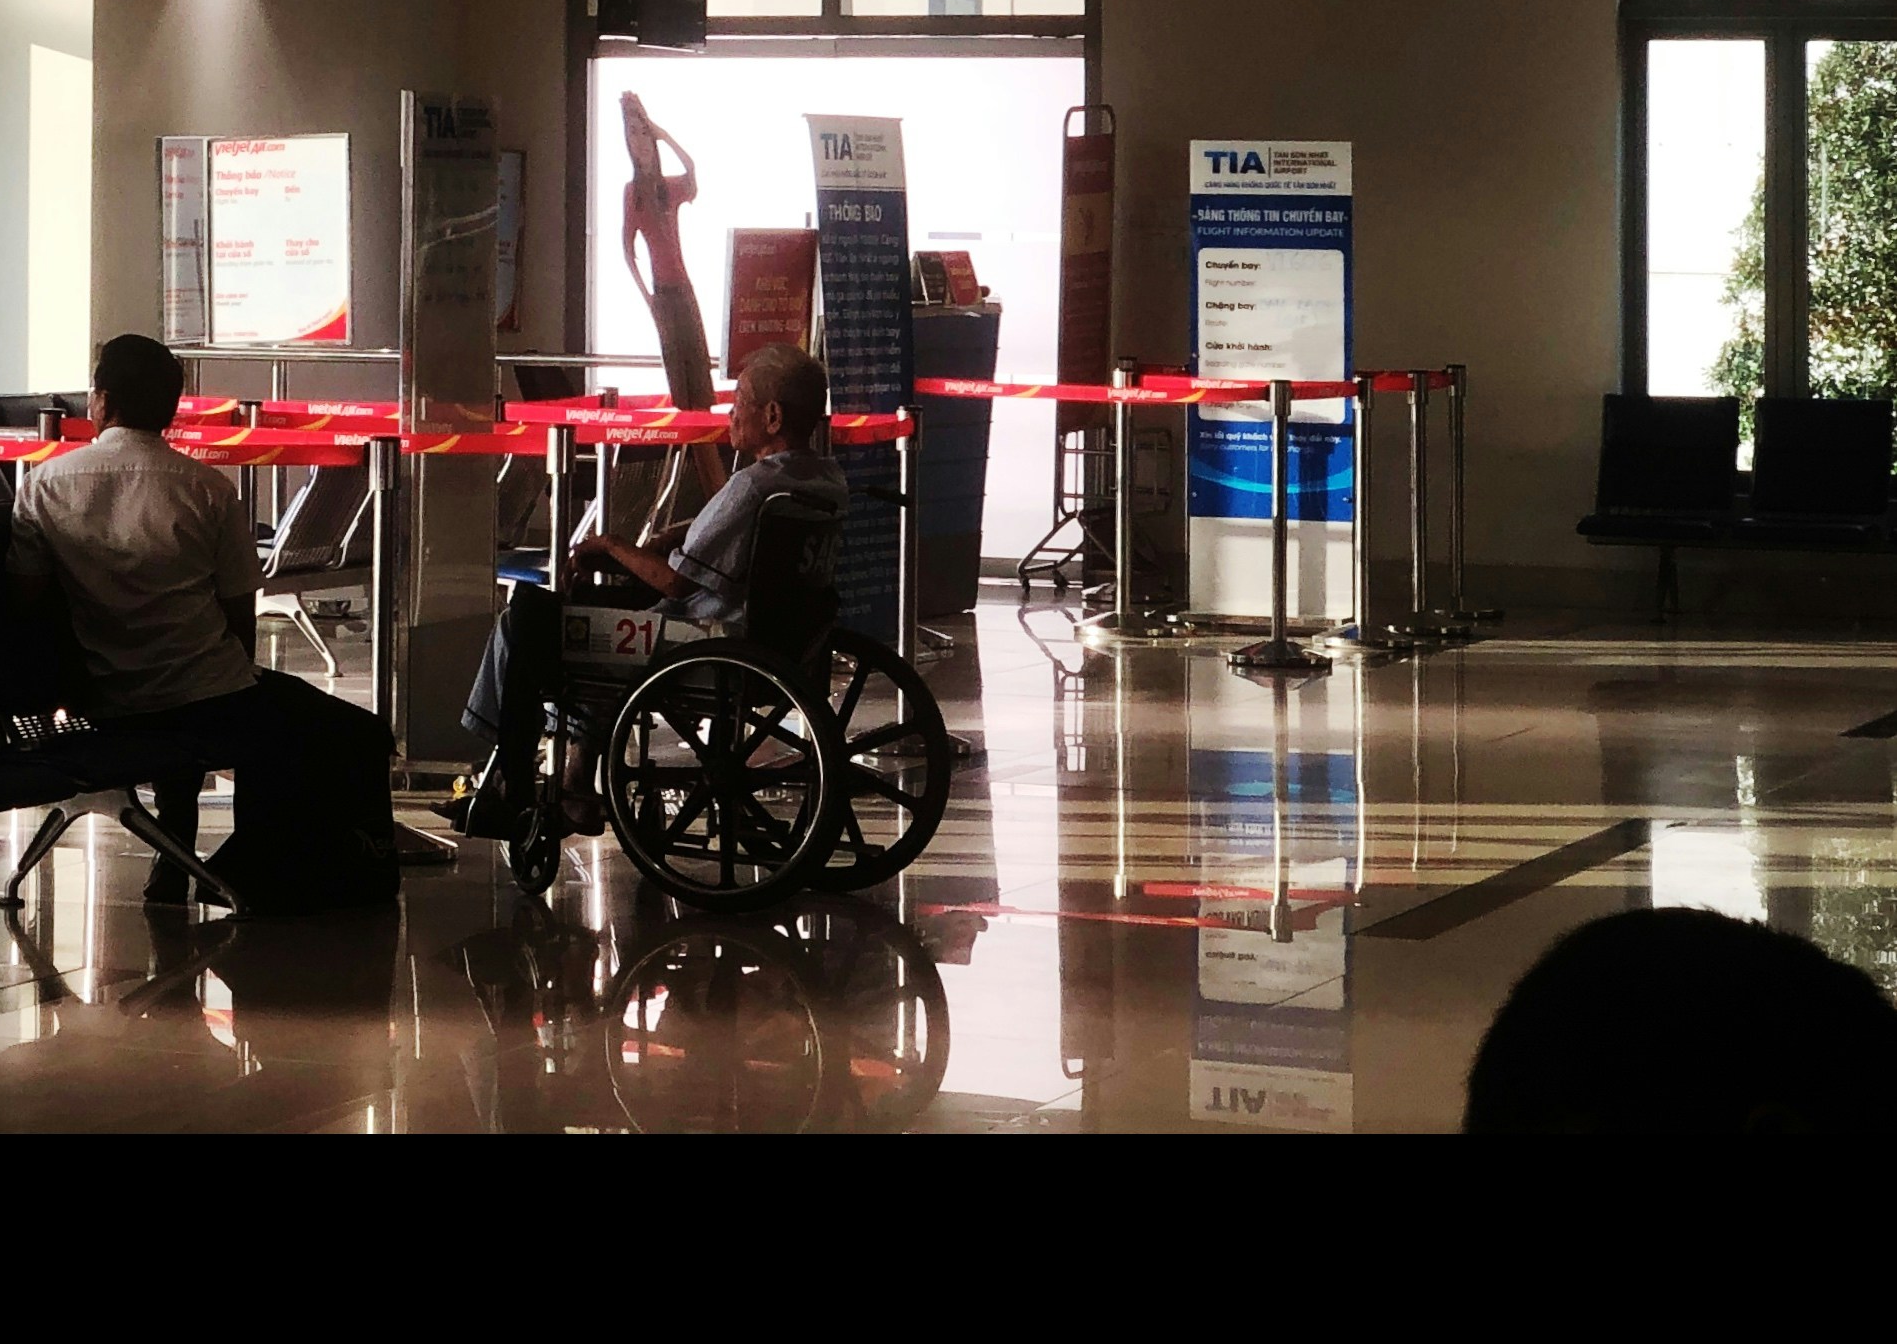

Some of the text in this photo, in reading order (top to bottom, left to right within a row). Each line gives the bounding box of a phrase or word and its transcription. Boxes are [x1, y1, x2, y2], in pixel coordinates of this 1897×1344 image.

[820, 132, 854, 161] TIA
[1204, 151, 1265, 174] TIA
[1263, 209, 1280, 223] TIN
[1233, 227, 1303, 237] INFORMATION
[615, 618, 653, 656] 21
